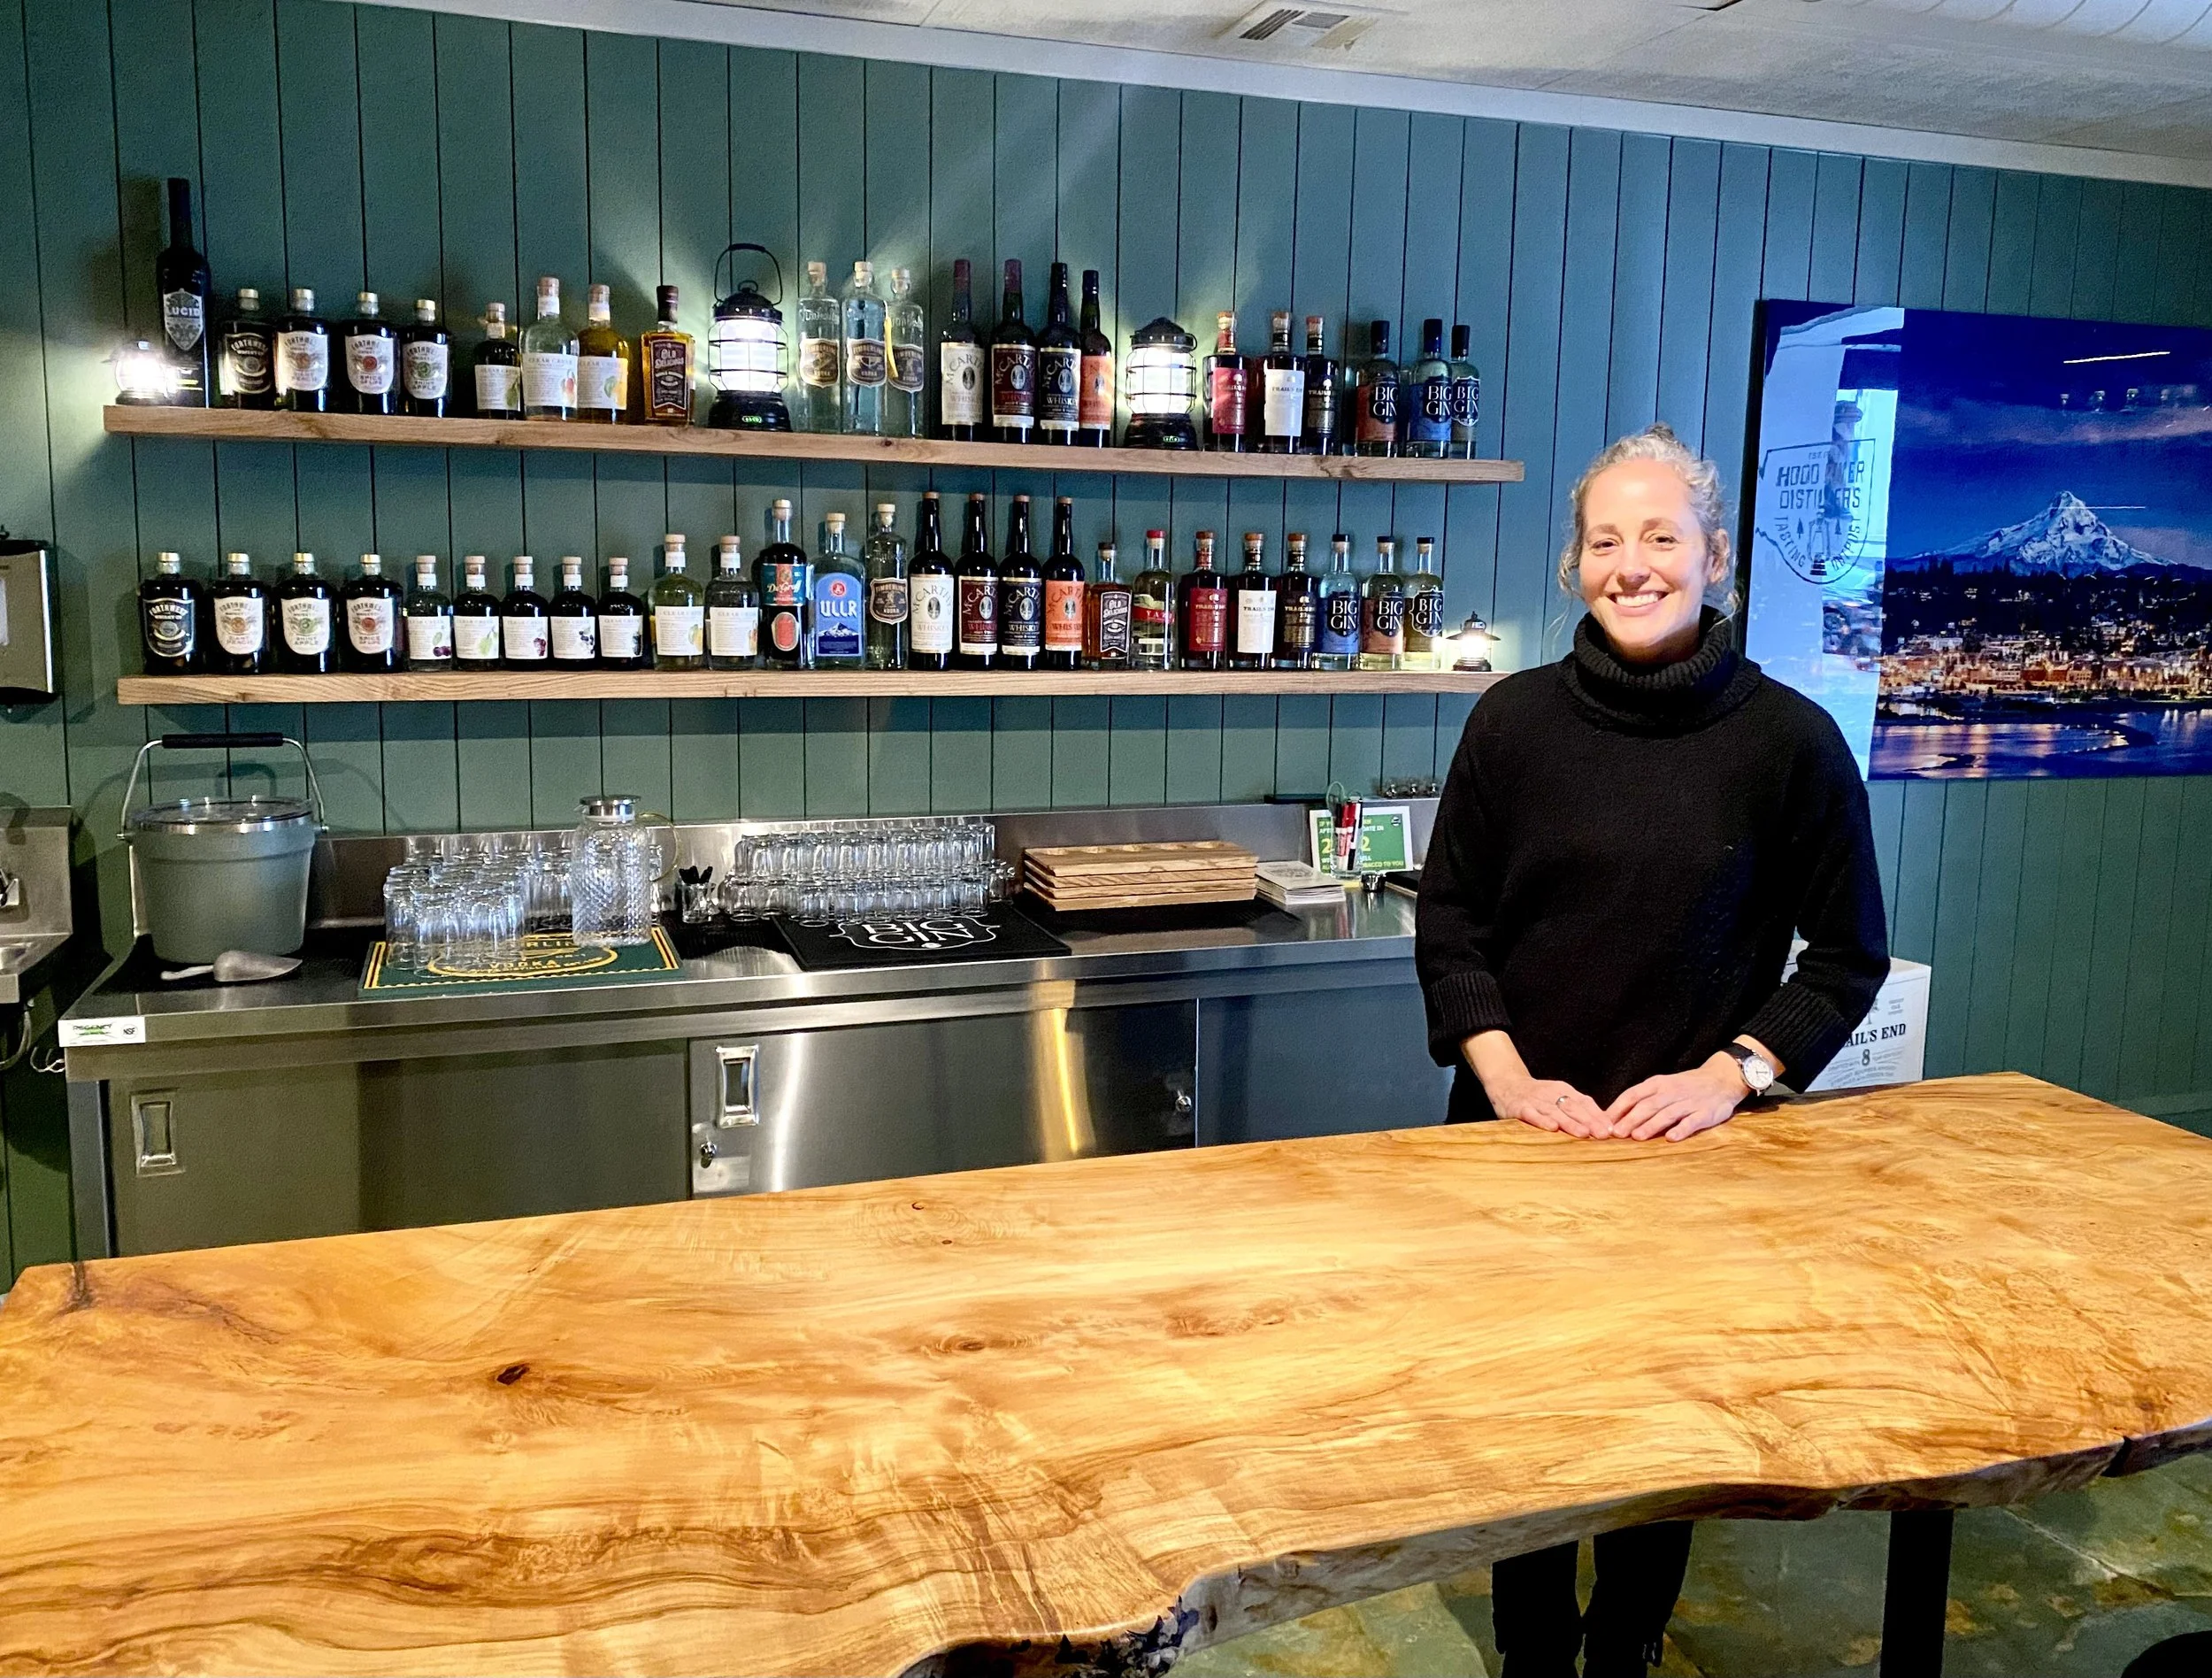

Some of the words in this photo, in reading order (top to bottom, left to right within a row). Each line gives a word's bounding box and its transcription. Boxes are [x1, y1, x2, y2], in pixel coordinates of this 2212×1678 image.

[1375, 386, 1398, 402] BIG
[1428, 386, 1452, 401] BIG
[1457, 386, 1479, 400] BIG
[1372, 401, 1397, 417] GIN
[1426, 400, 1451, 416] GIN
[1454, 399, 1479, 413] GIN
[1776, 464, 1820, 487] HOOD
[1774, 515, 1806, 568] TASTING
[820, 600, 857, 618] ULLR
[1332, 600, 1357, 614] BIG
[1379, 601, 1403, 615] BIG
[1419, 598, 1442, 612] BIG
[1331, 615, 1356, 629] GIN
[1377, 615, 1403, 630] GIN
[1416, 612, 1442, 625] GIN
[862, 920, 965, 935] BIG
[868, 929, 975, 944] GIN
[489, 960, 562, 969] VODKA
[123, 1027, 136, 1035] NSF
[1845, 1029, 1878, 1047] AIL'S
[1881, 1023, 1907, 1040] END
[1862, 1049, 1870, 1066] 8
